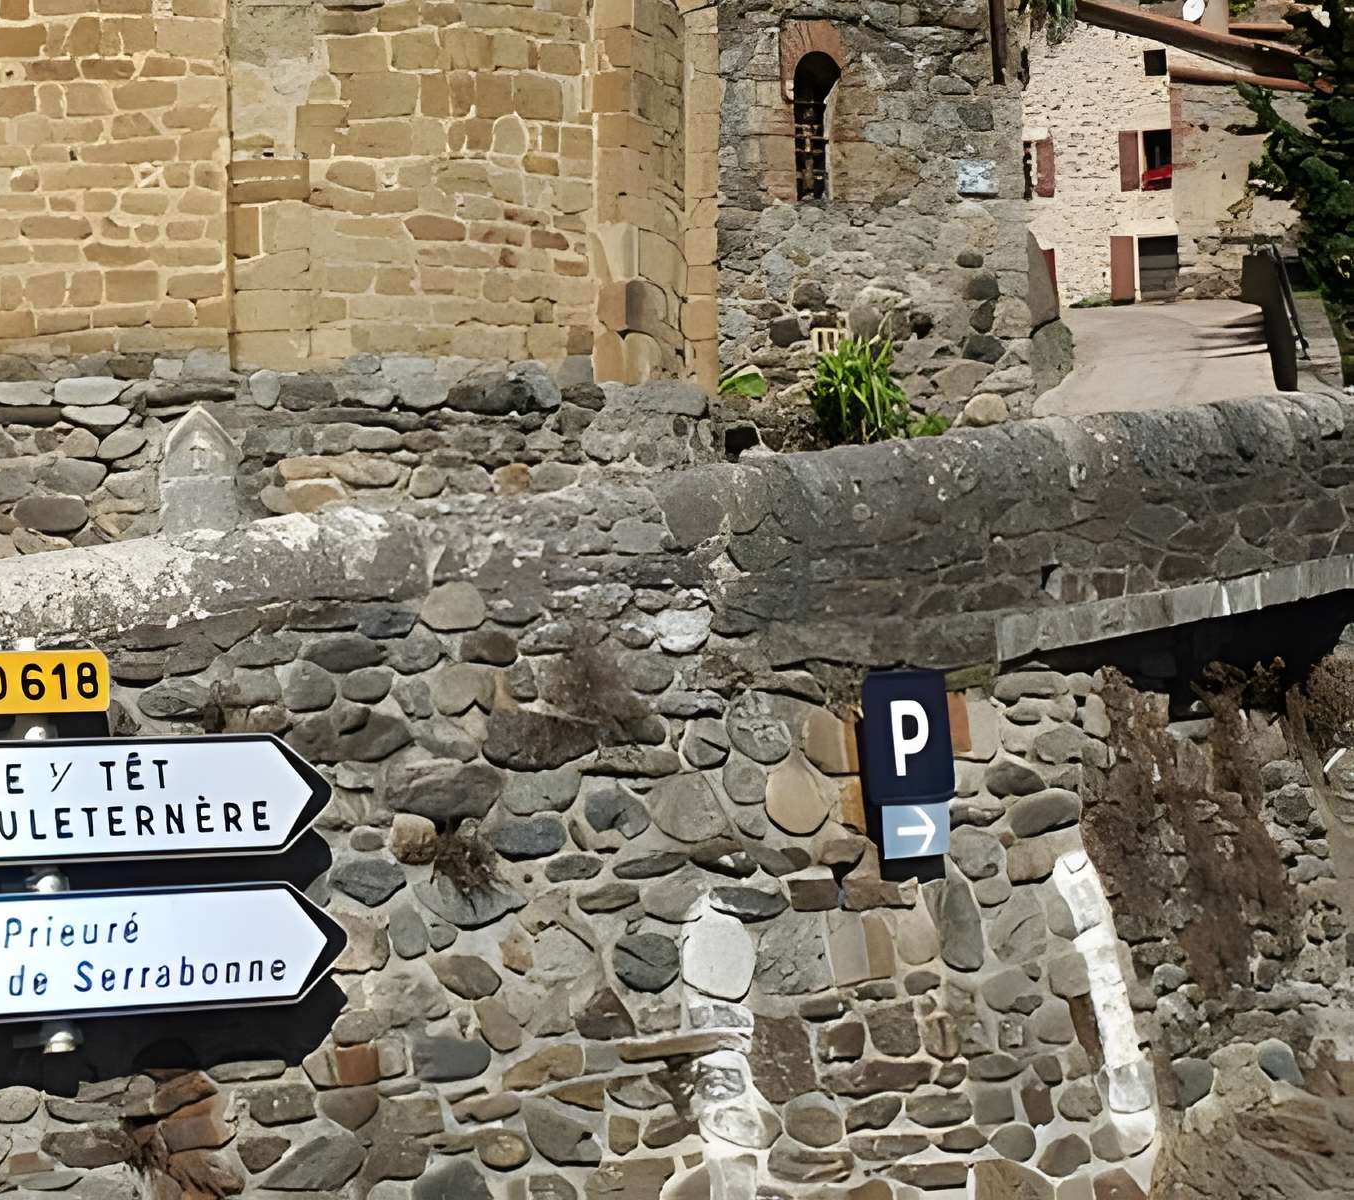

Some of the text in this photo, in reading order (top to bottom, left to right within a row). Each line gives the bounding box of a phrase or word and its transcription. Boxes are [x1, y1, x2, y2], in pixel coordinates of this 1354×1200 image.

[890, 700, 929, 777] P
[4, 912, 140, 949] Prieuré
[9, 956, 288, 997] de Serrabonne
